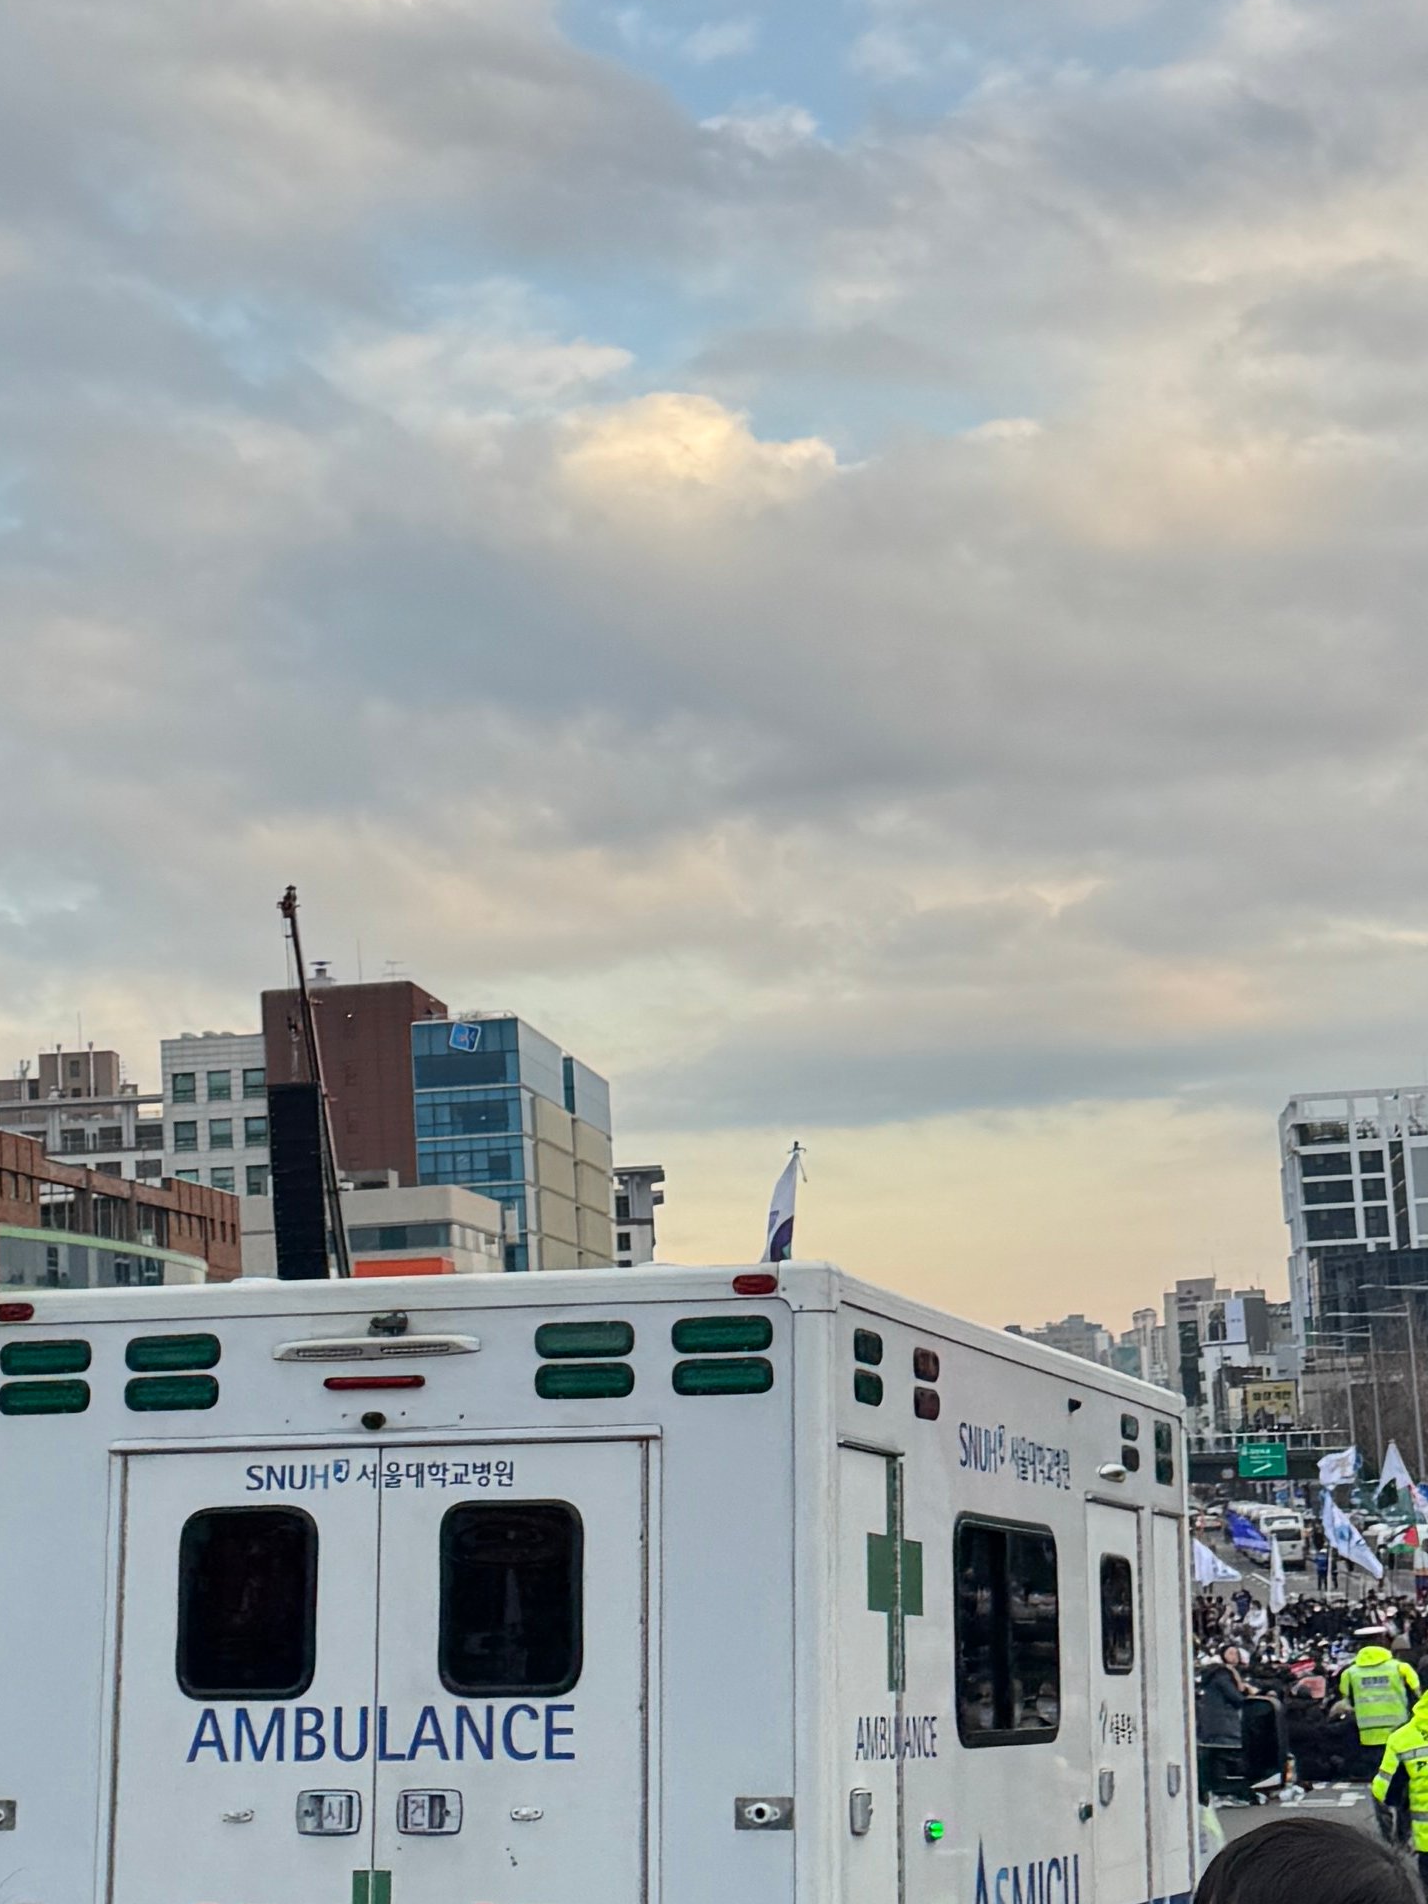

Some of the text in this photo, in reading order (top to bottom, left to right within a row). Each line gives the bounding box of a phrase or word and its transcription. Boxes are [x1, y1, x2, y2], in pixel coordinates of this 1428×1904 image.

[959, 1422, 997, 1474] SNUH
[246, 1464, 329, 1490] SNUH
[357, 1460, 514, 1489] 서울대학교병원
[186, 1703, 576, 1763] AMBULANCE
